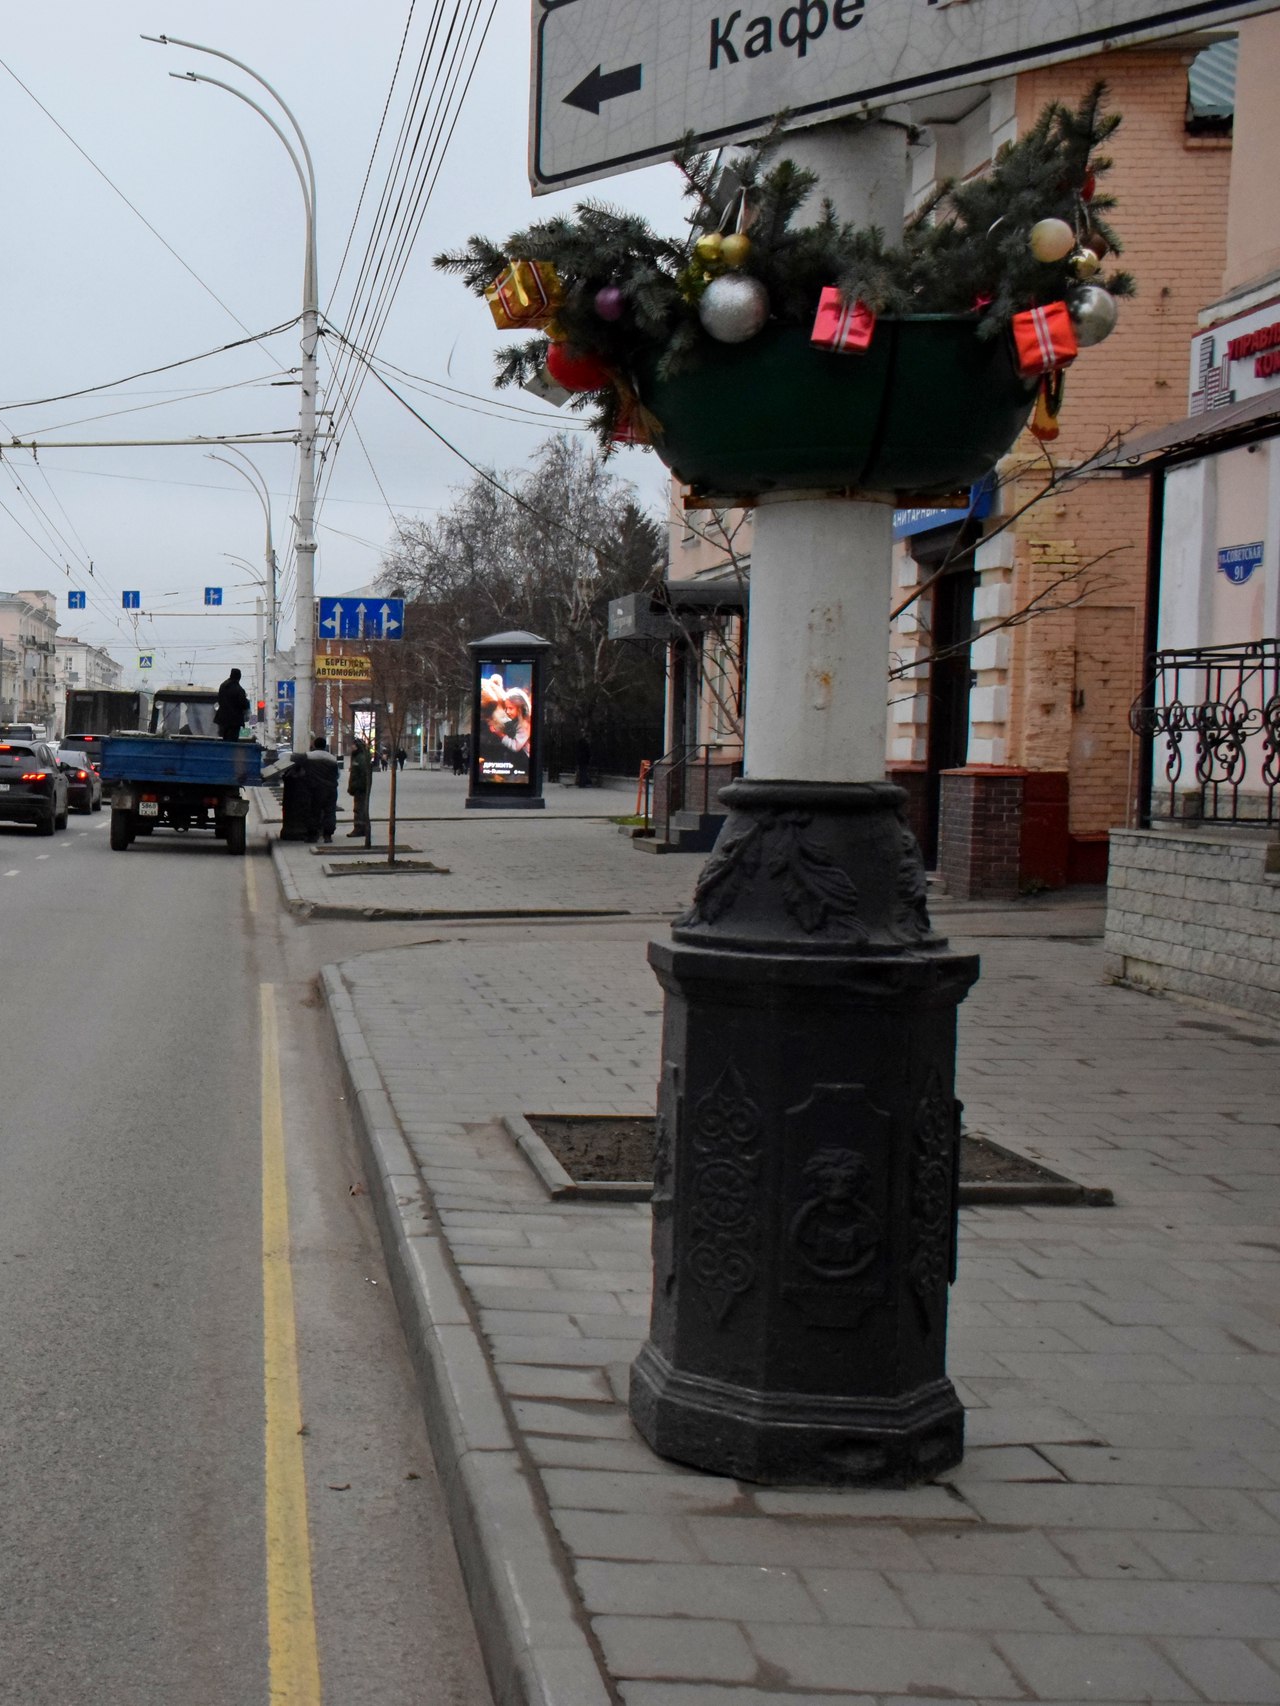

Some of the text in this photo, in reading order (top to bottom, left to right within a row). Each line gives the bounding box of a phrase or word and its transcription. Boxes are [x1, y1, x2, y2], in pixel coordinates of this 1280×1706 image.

[709, 0, 866, 71] Кафе
[1227, 321, 1280, 361] УПРАВЛ
[1234, 565, 1244, 580] 91
